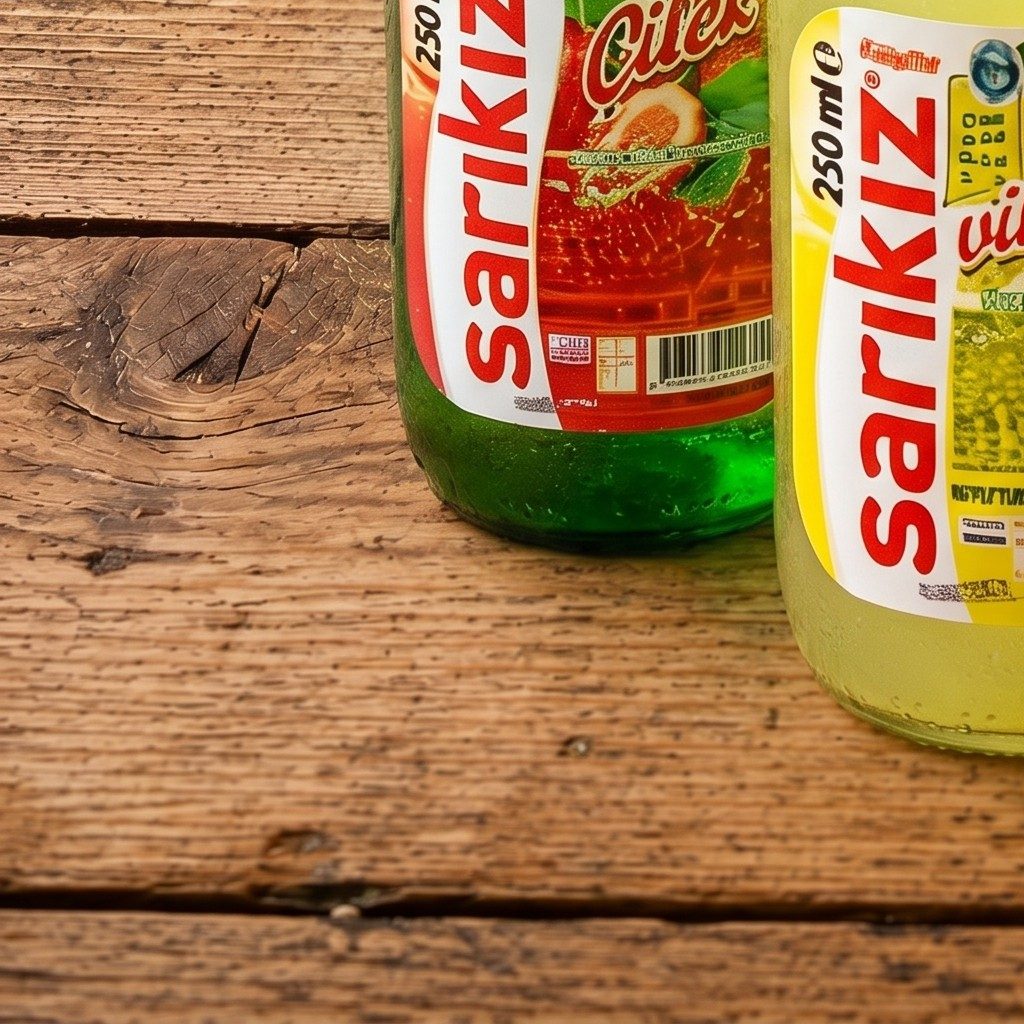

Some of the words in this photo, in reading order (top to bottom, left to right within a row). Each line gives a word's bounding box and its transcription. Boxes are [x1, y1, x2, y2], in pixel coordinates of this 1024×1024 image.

[414, 4, 441, 72] 250
[810, 75, 843, 131] ml
[811, 131, 843, 208] 250
